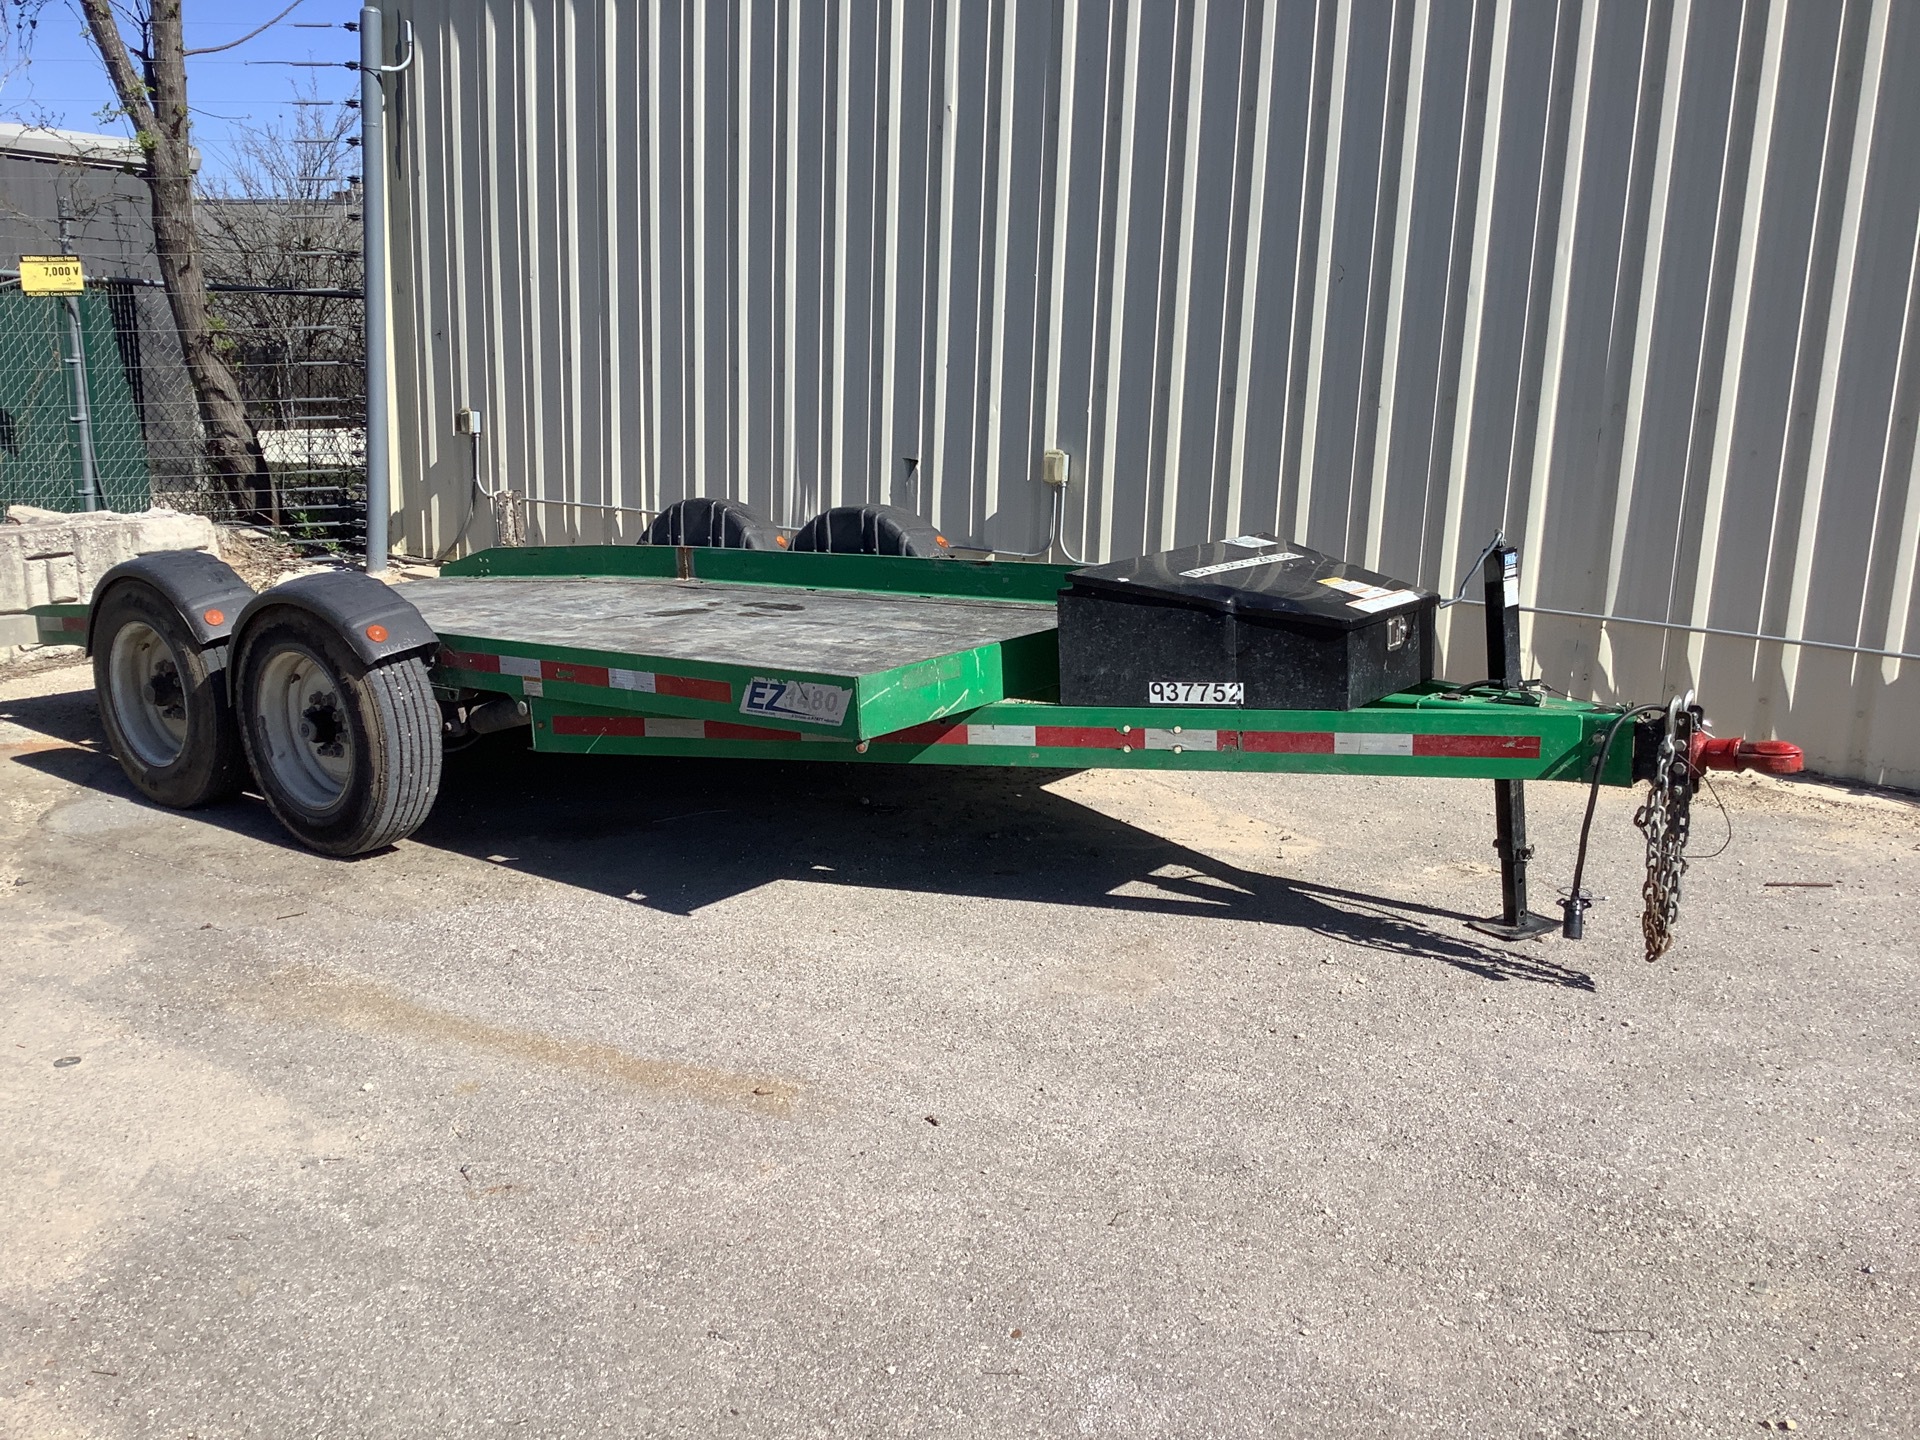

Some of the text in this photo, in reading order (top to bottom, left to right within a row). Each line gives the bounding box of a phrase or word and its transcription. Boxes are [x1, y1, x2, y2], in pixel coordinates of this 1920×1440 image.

[43, 266, 79, 277] 7,000 V
[747, 681, 787, 712] EZ
[1151, 682, 1242, 703] 937752
